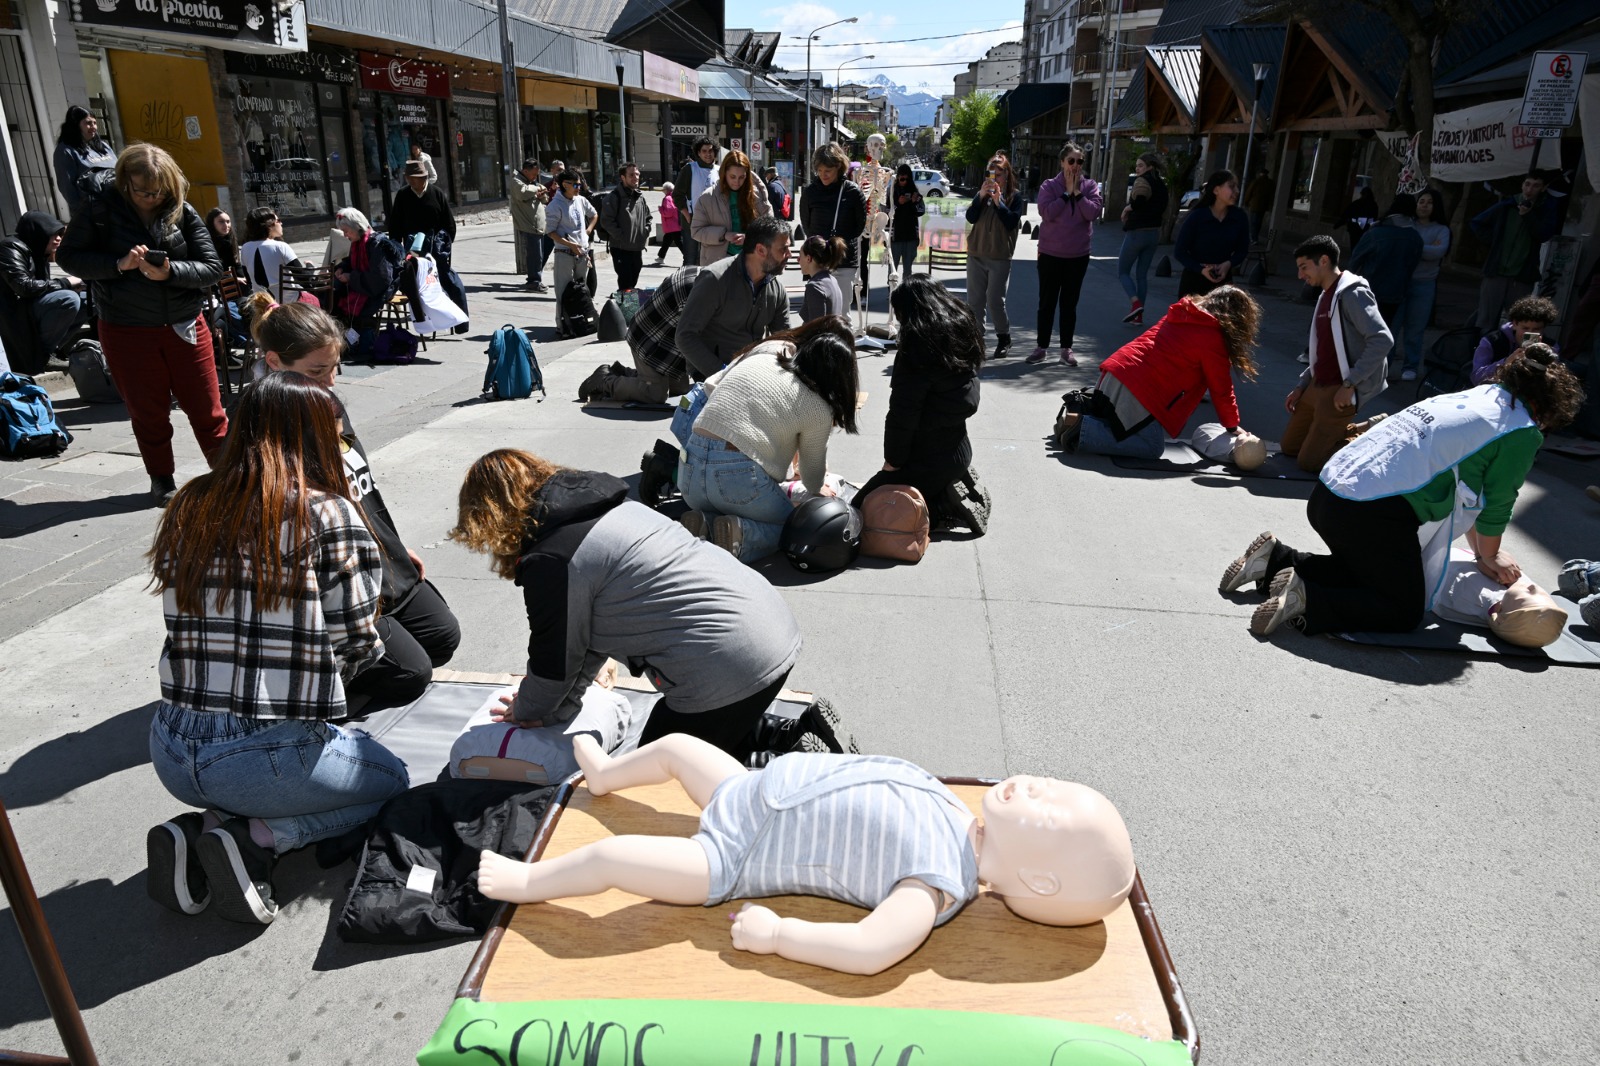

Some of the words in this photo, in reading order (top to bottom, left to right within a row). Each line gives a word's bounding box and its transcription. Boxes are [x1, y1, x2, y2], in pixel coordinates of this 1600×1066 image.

[162, 0, 224, 23] previa
[173, 17, 191, 25] TRAGOS
[195, 20, 215, 28] CERVEZA
[266, 59, 312, 73] TENDENCAS
[397, 104, 426, 113] FABRICA
[453, 105, 483, 120] FABRICA
[484, 109, 494, 120] DE
[399, 115, 427, 124] CAMPERAS
[454, 119, 495, 133] CAMPERAS
[1406, 405, 1435, 425] CESAB
